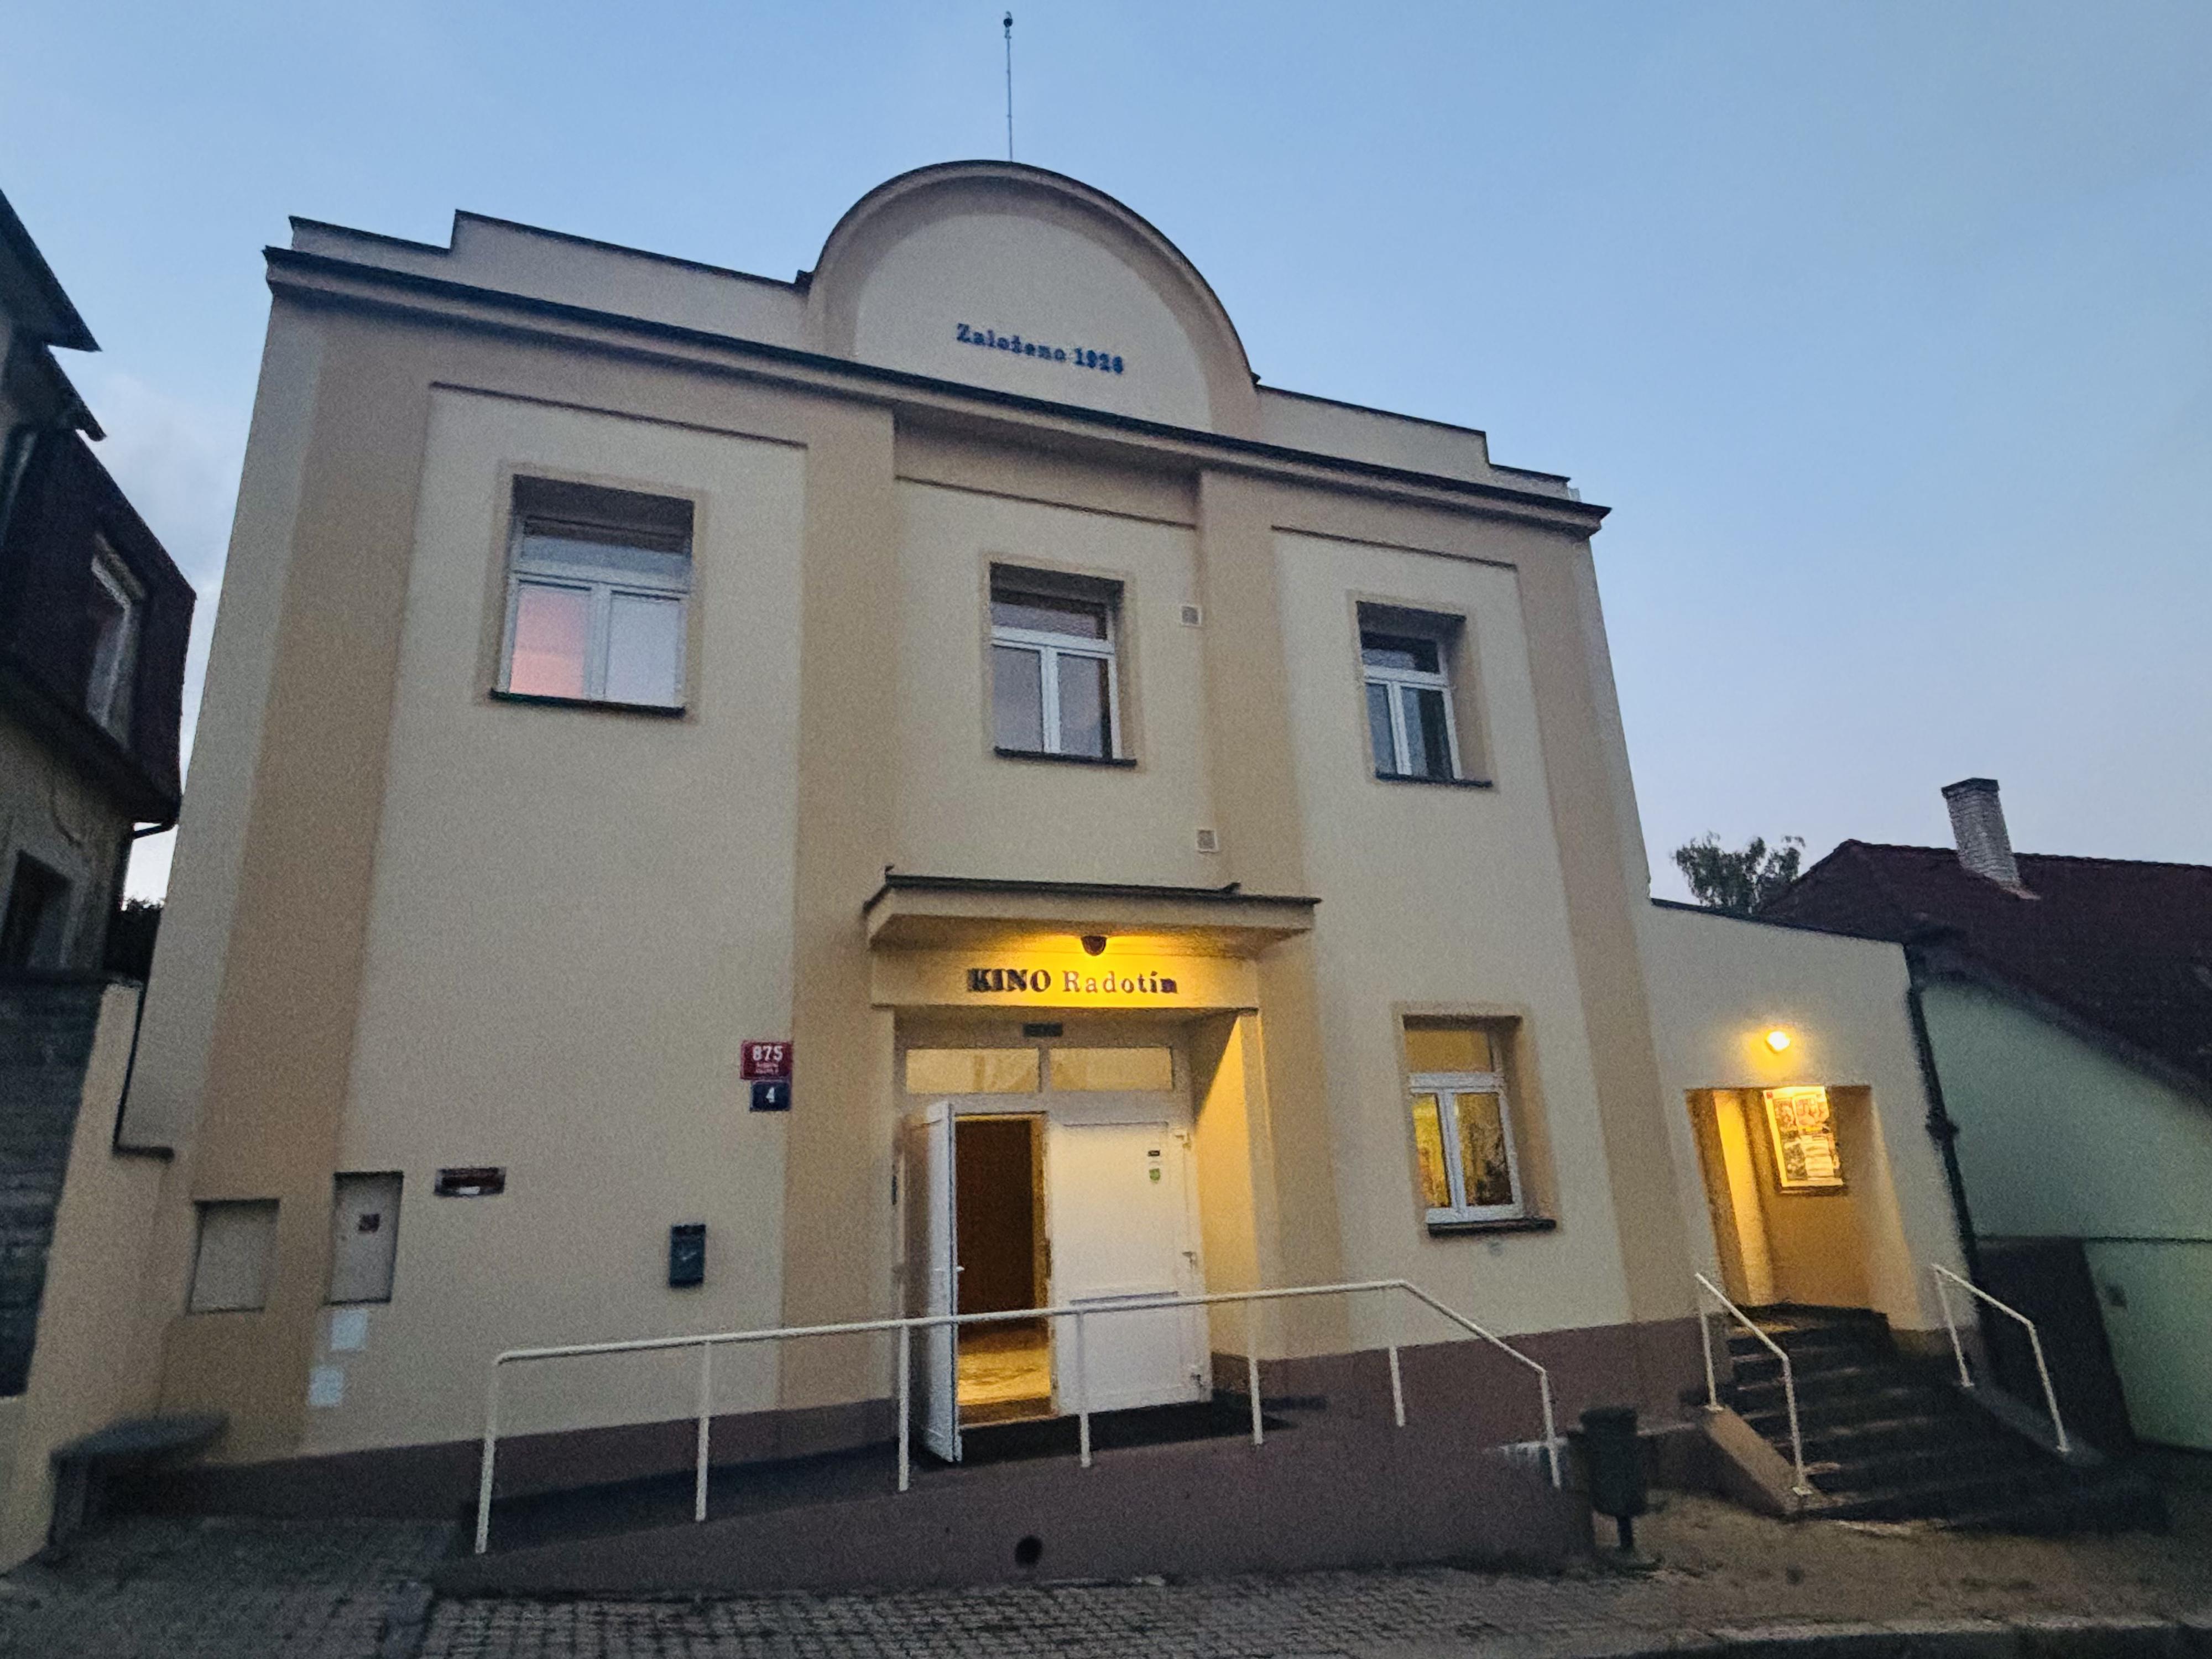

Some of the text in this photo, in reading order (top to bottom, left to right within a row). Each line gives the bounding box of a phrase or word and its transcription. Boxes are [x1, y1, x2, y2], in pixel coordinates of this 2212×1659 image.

[968, 969, 1177, 994] KINO Radotín
[753, 1045, 783, 1061] 875
[766, 1087, 775, 1103] 4
